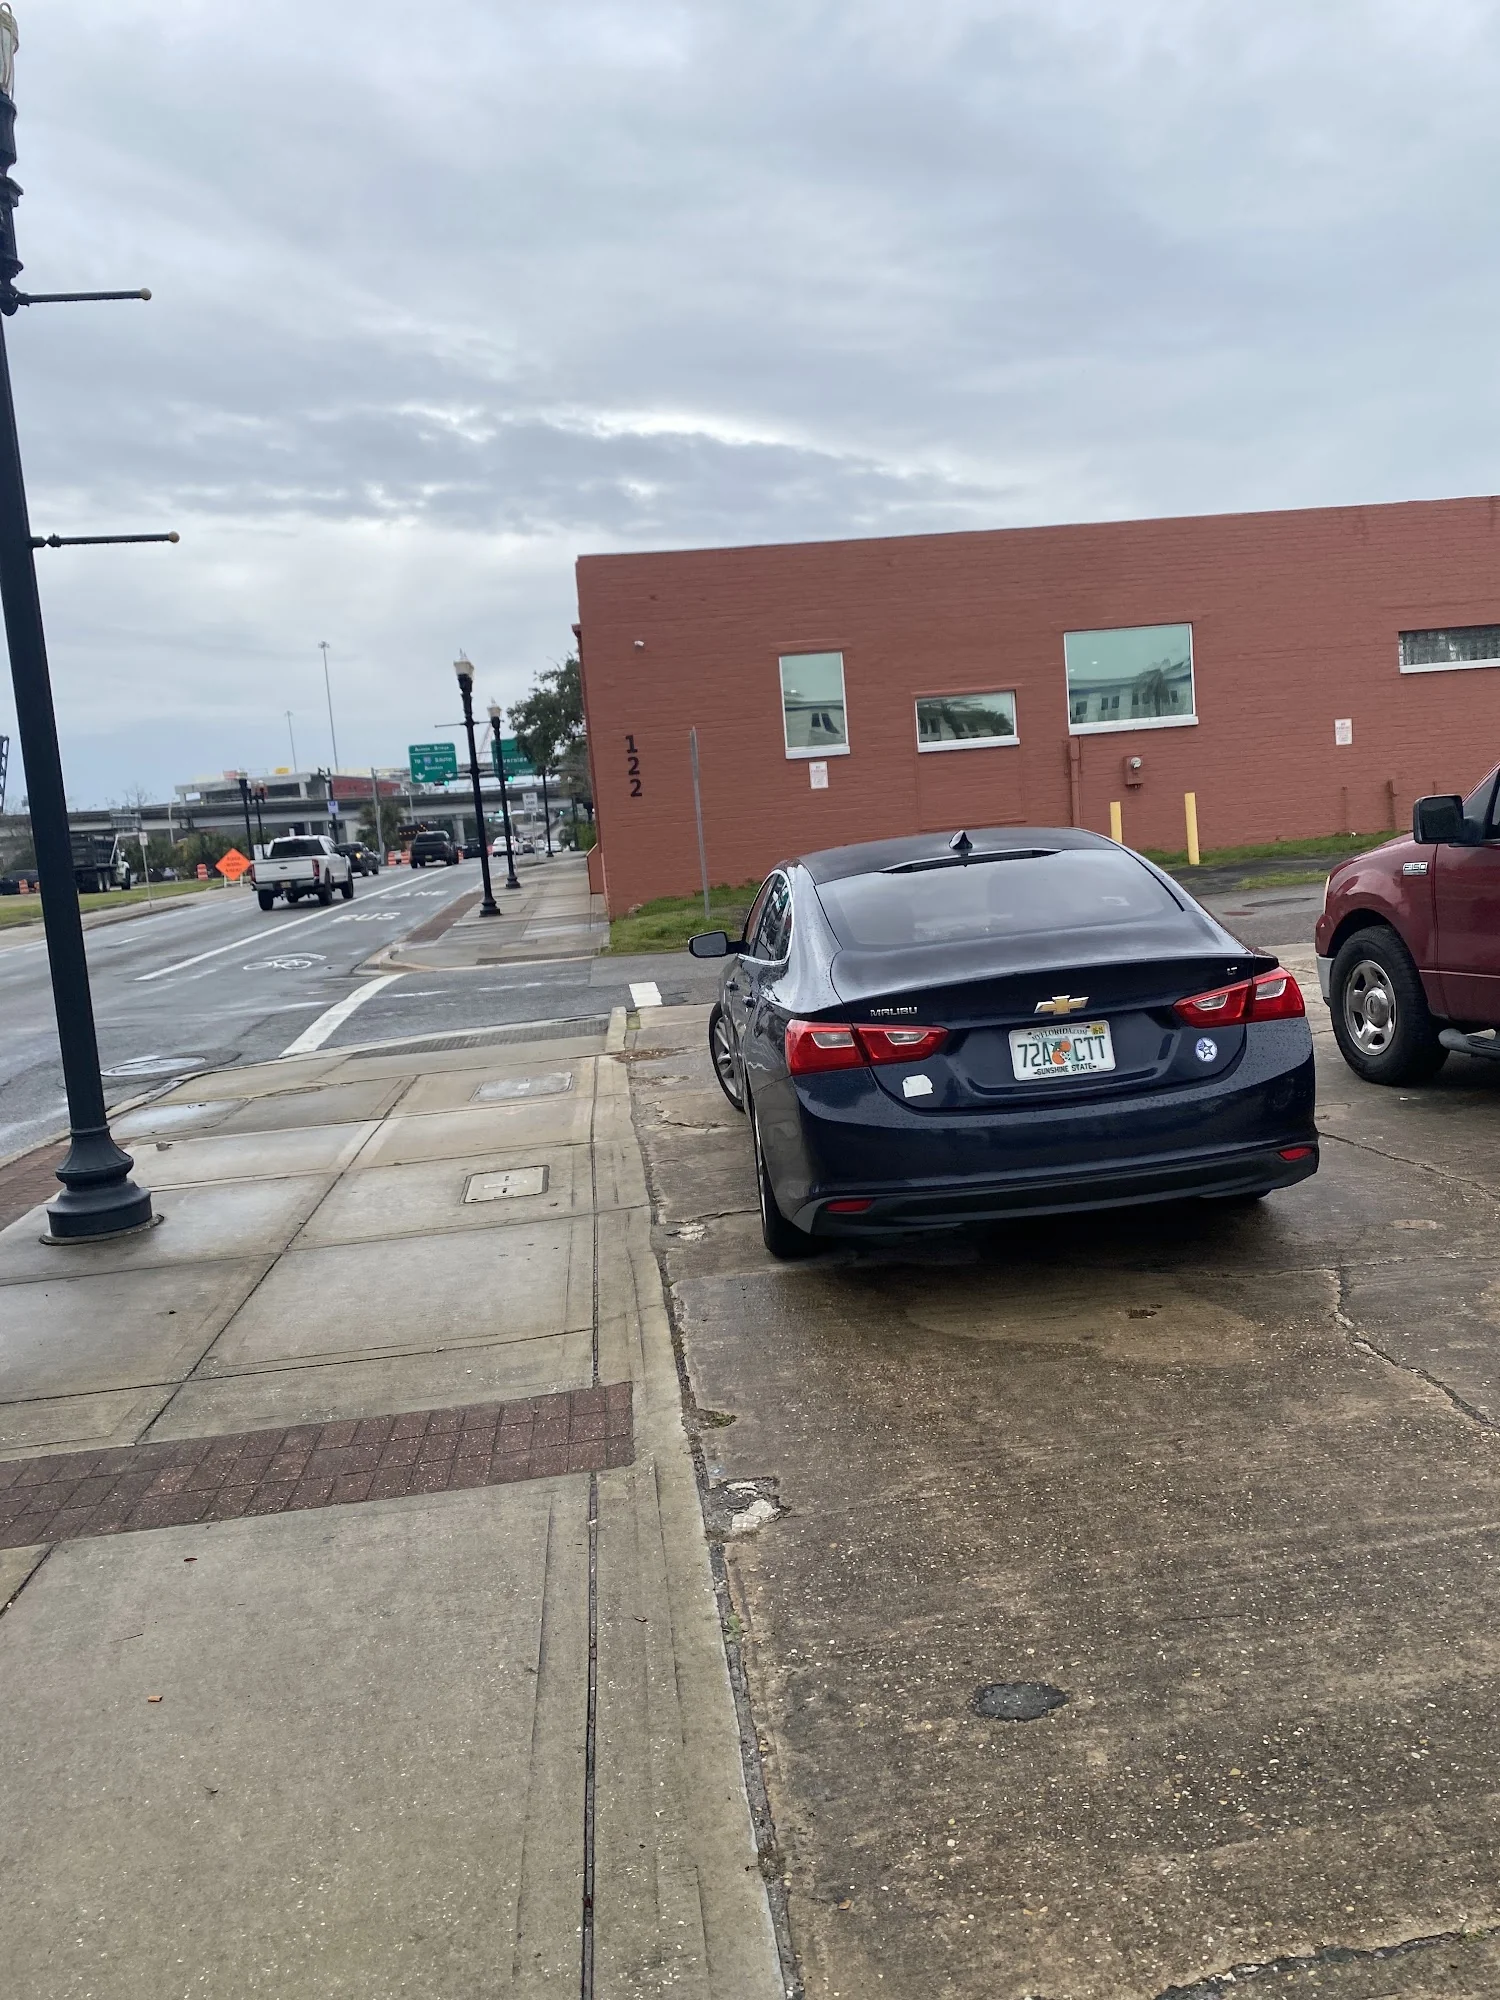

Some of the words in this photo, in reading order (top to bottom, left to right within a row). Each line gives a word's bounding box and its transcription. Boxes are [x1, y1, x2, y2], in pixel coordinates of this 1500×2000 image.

[625, 734, 643, 797] 122
[331, 912, 401, 923] BUS
[870, 1006, 918, 1017] MALIBU
[1071, 1062, 1093, 1072] STATE
